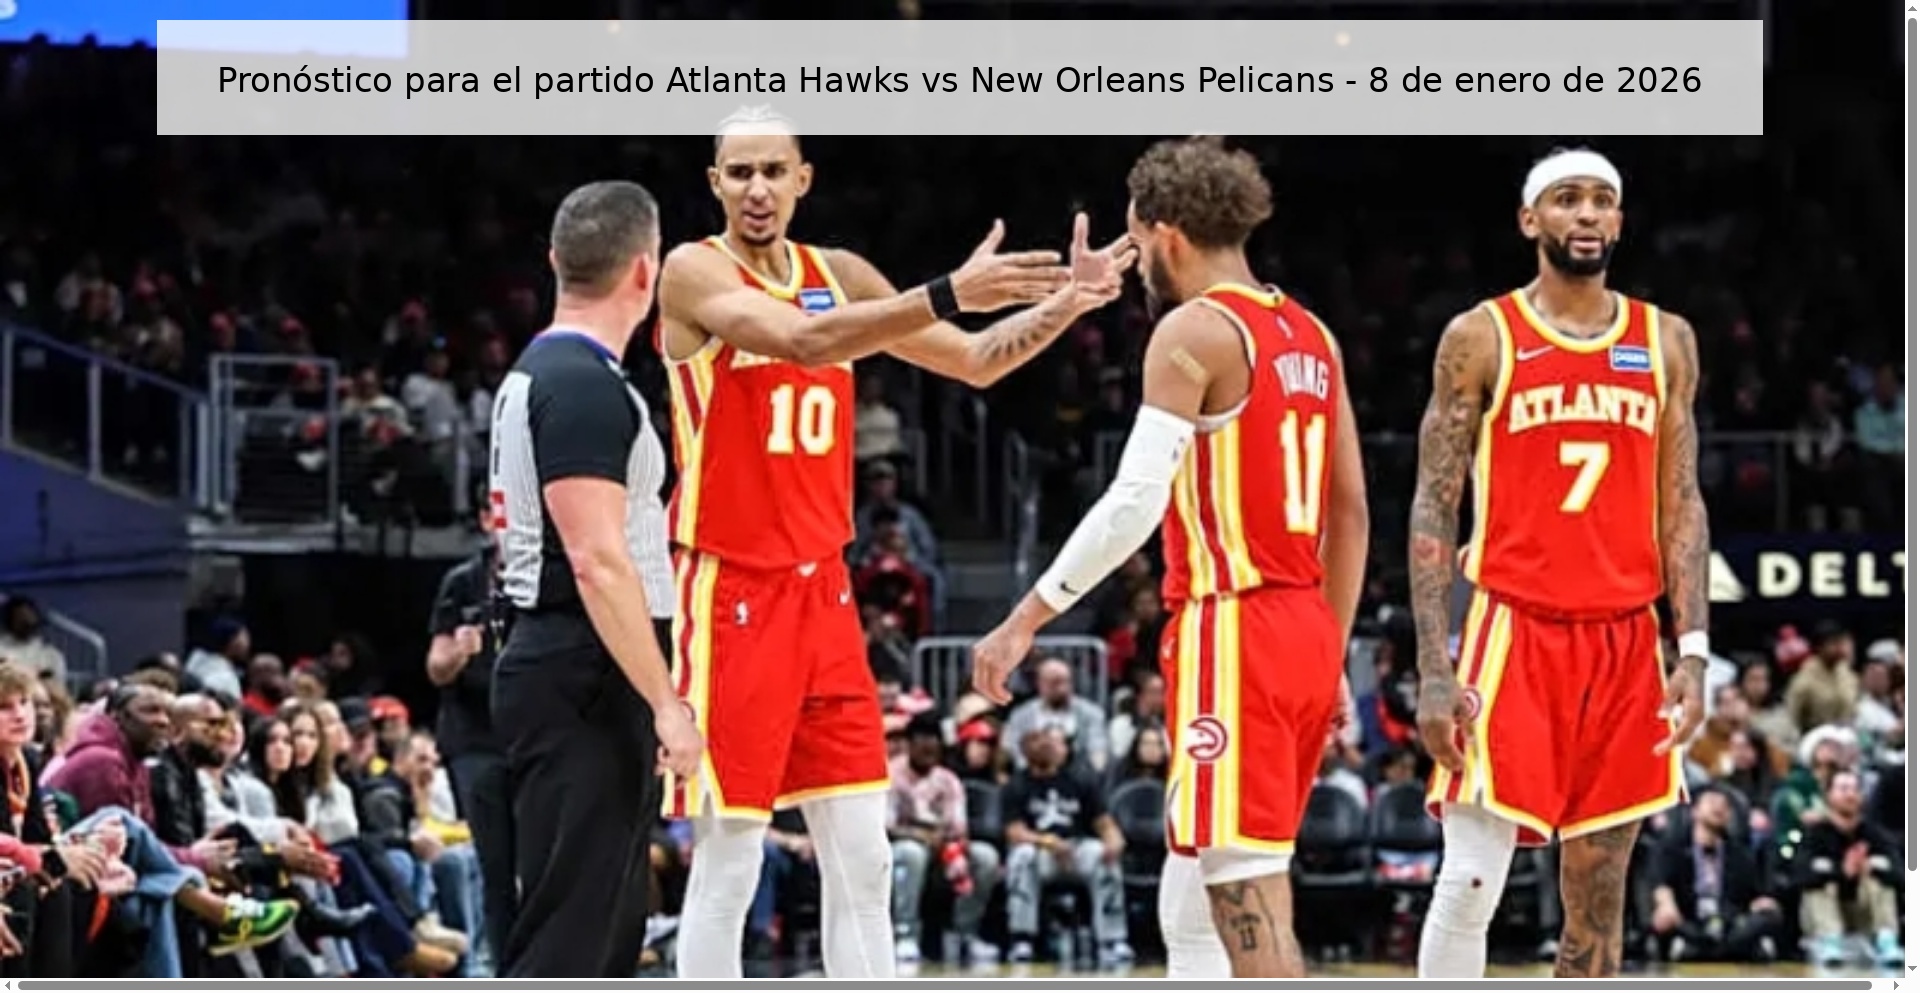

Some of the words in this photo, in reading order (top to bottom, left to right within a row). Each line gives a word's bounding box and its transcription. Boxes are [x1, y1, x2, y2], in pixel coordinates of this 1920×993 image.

[766, 383, 837, 456] 10
[1279, 408, 1327, 535] 11
[1558, 440, 1611, 514] 7
